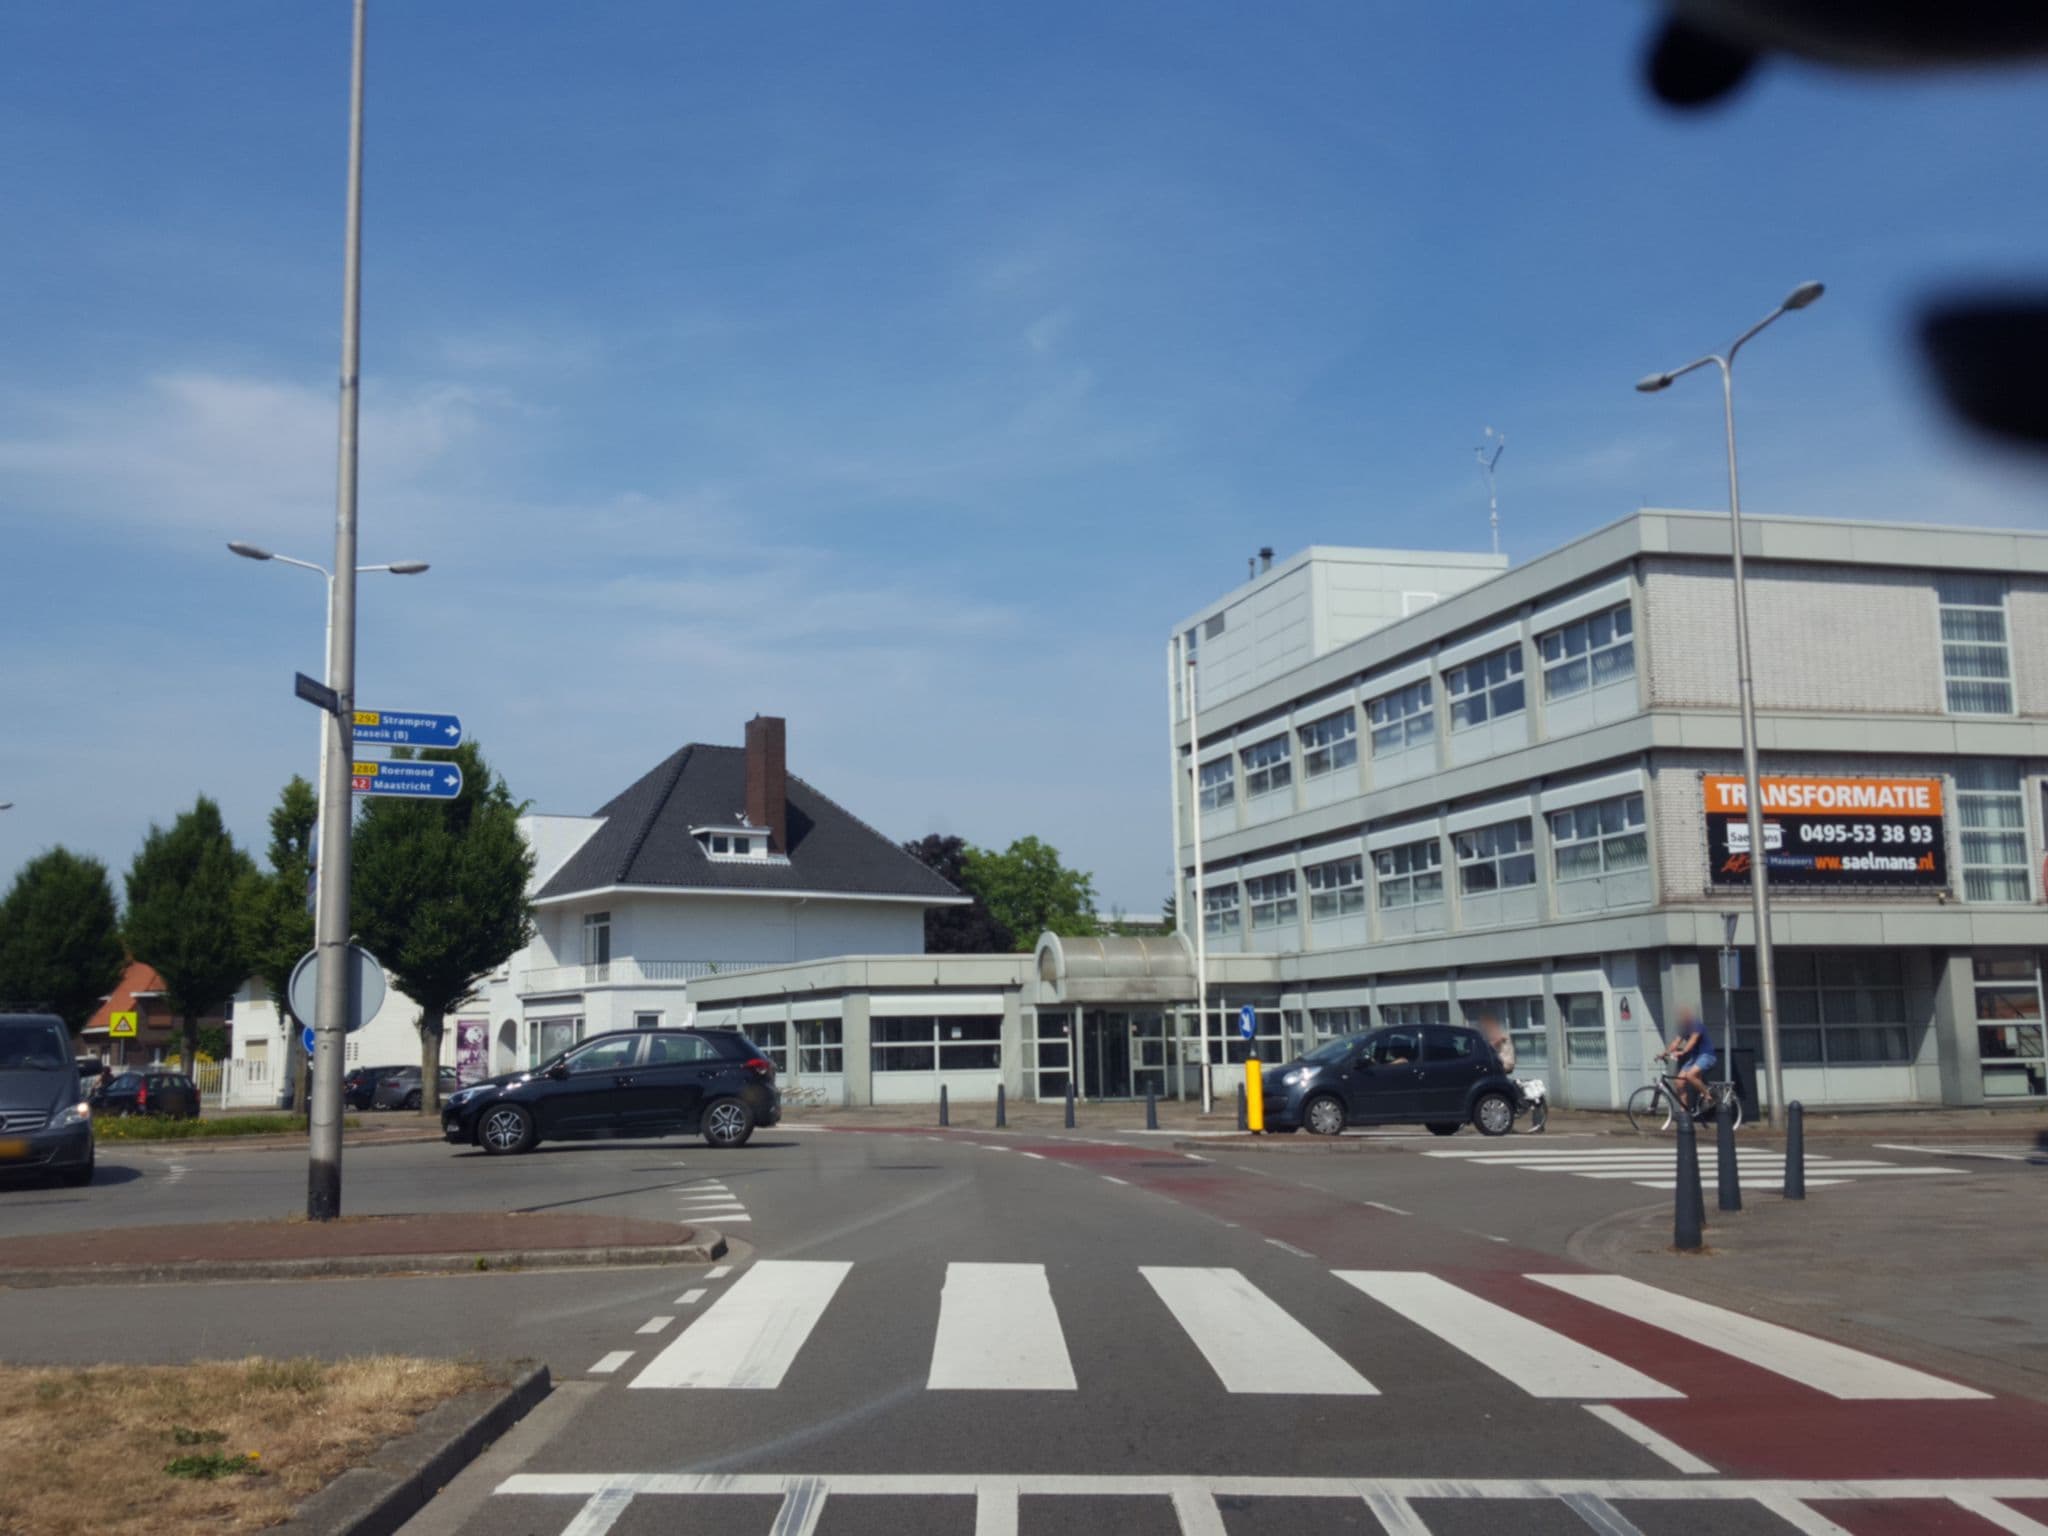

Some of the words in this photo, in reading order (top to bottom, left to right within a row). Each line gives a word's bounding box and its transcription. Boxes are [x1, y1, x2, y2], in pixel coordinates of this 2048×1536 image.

[382, 715, 438, 729] Stramproy
[393, 730, 409, 741] (B)
[352, 764, 377, 775] 280
[380, 766, 435, 778] Roermond
[374, 779, 432, 792] Maastricht
[1730, 832, 1779, 843] Saens
[1800, 823, 1876, 843] 0495-53
[1881, 824, 1904, 844] 38
[1909, 825, 1933, 844] 93
[1807, 851, 1935, 871] ww.saelmans.nl
